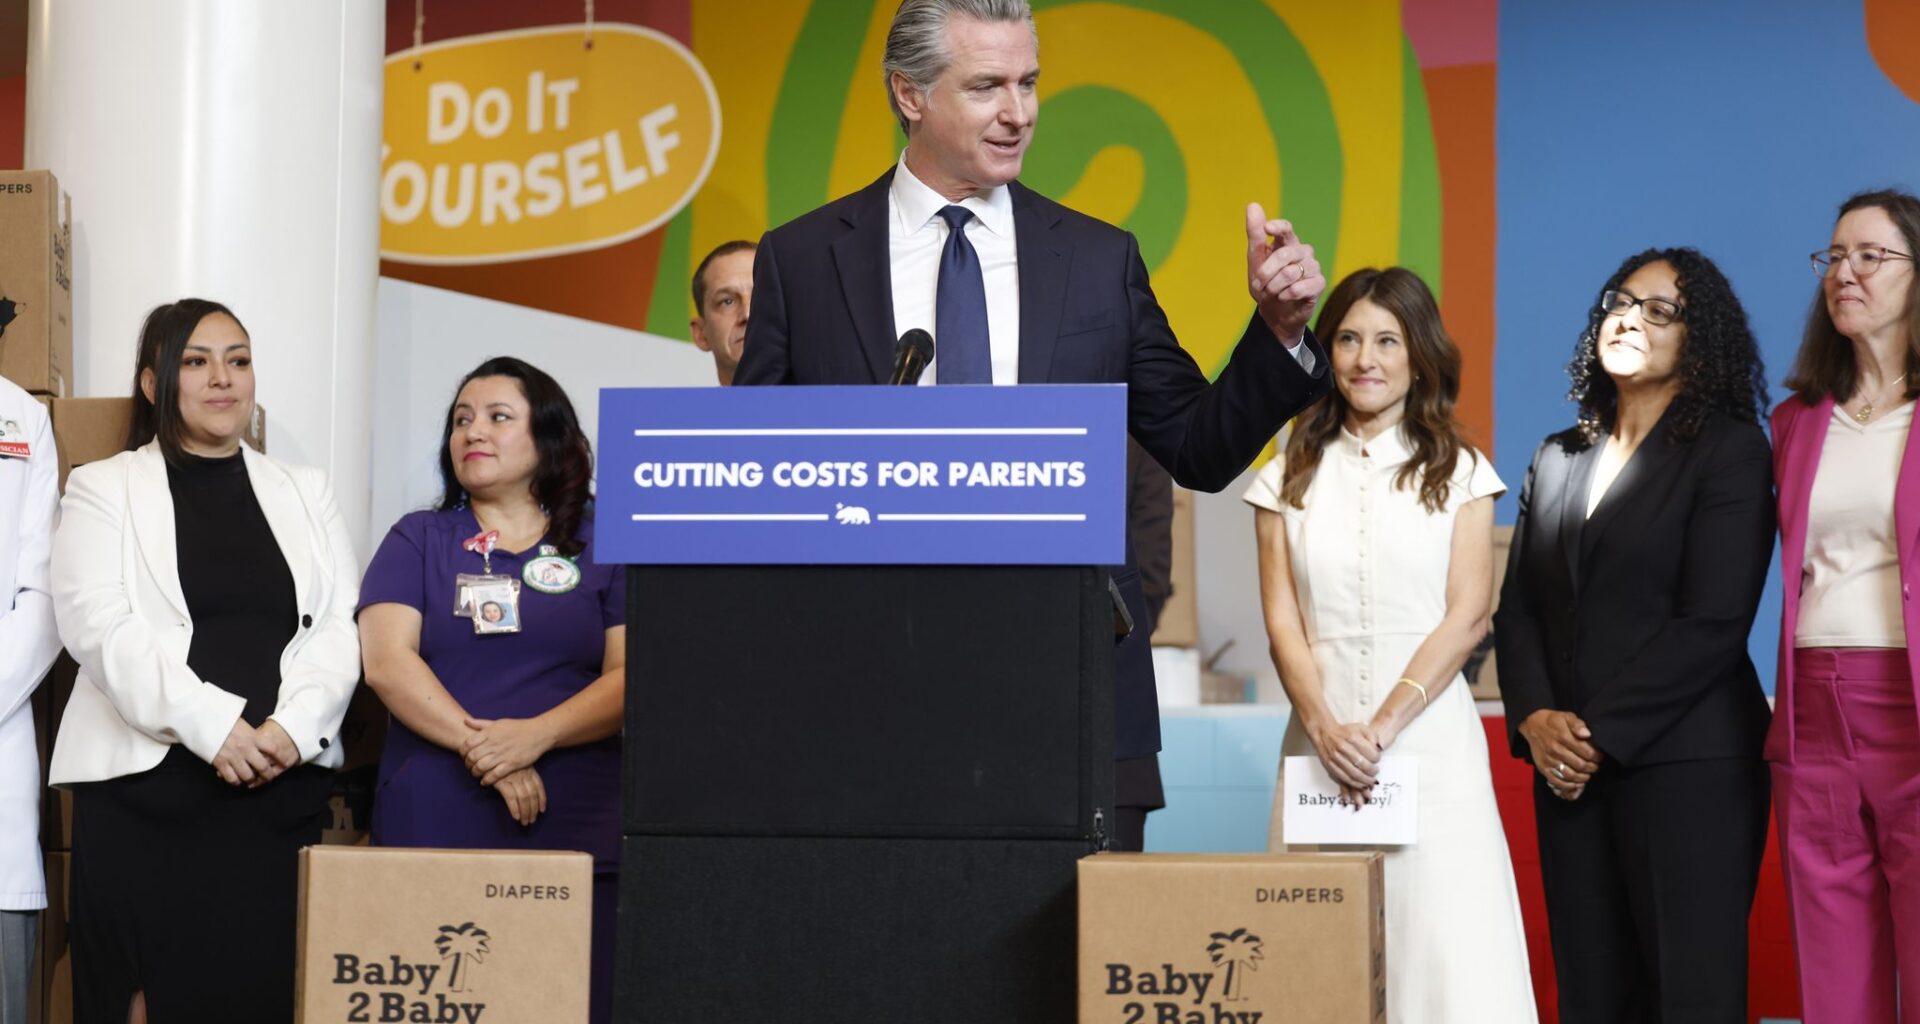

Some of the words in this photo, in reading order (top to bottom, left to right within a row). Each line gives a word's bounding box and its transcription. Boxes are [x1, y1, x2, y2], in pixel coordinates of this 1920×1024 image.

[633, 461, 763, 488] CUTTING
[772, 461, 868, 488] COSTS
[877, 461, 939, 488] FOR
[948, 461, 1086, 488] PARENTS
[485, 884, 570, 900] DIAPERS
[1256, 888, 1344, 903] DIAPERS
[333, 953, 440, 994] Baby
[1105, 964, 1214, 1004] Baby
